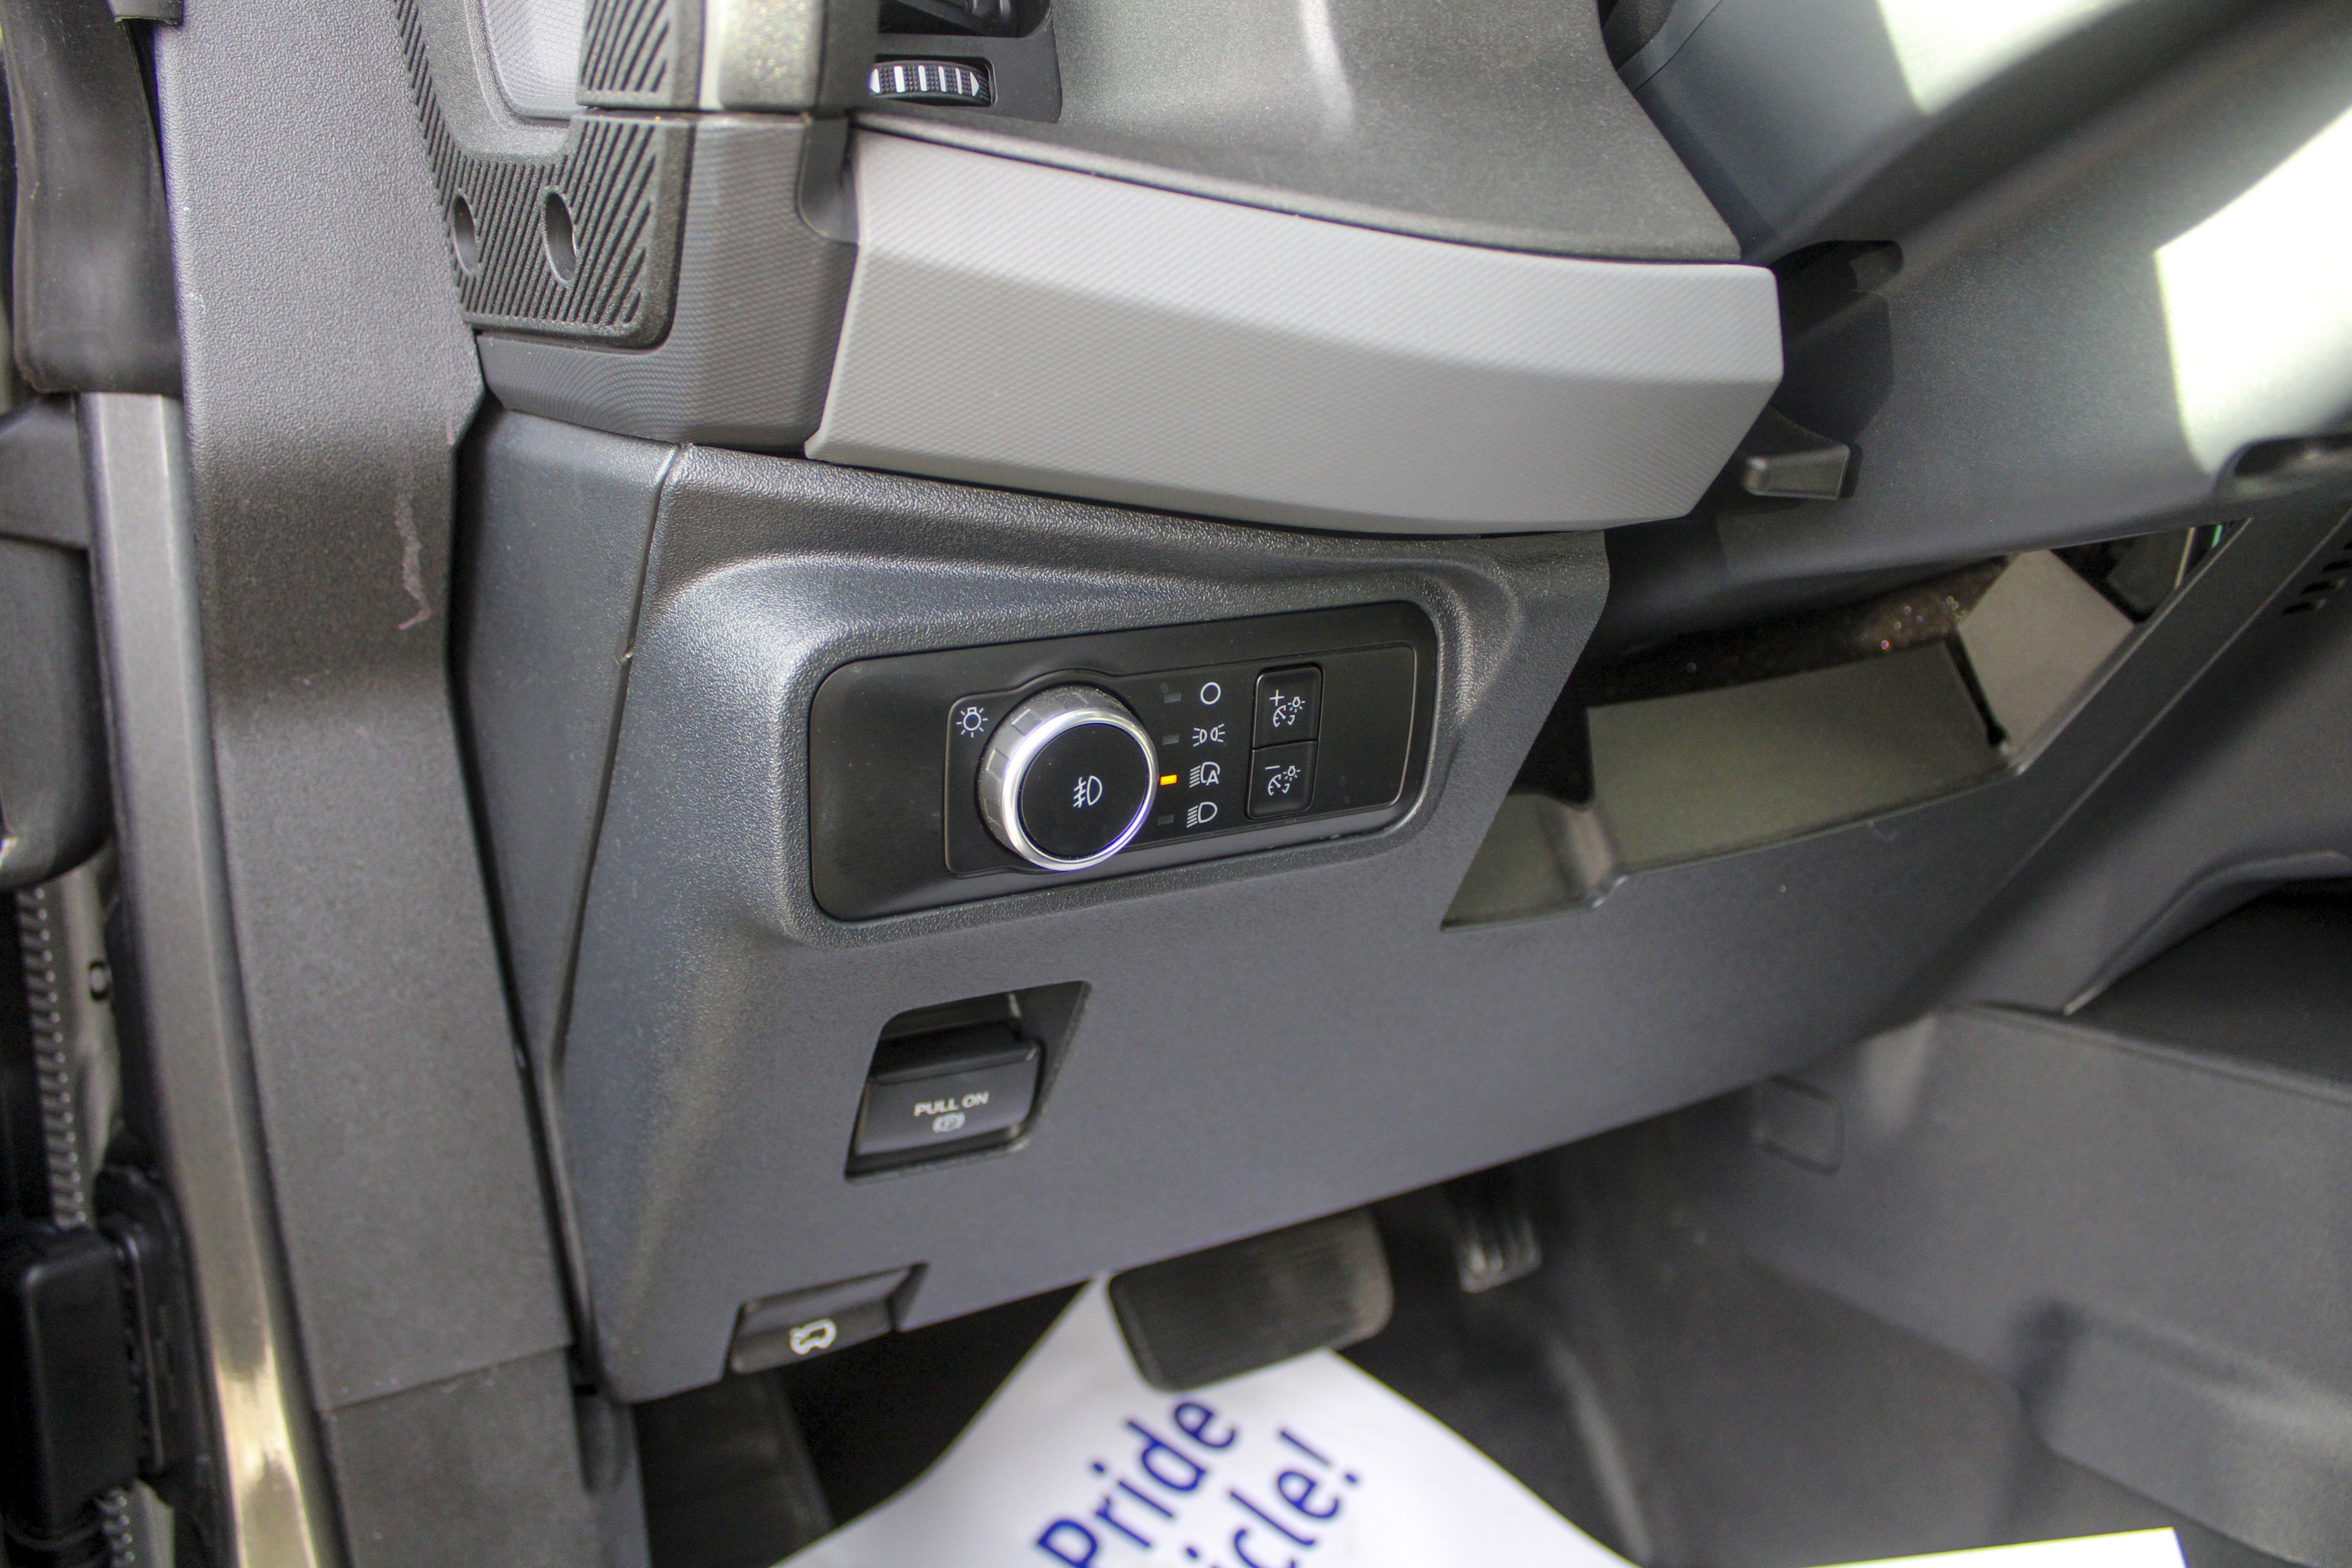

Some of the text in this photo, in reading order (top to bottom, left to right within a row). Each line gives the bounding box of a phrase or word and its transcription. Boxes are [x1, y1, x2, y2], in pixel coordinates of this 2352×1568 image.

[913, 1091, 990, 1117] PULL ON
[1036, 1401, 1236, 1568] Pride
[1186, 1430, 1358, 1568] cle!
